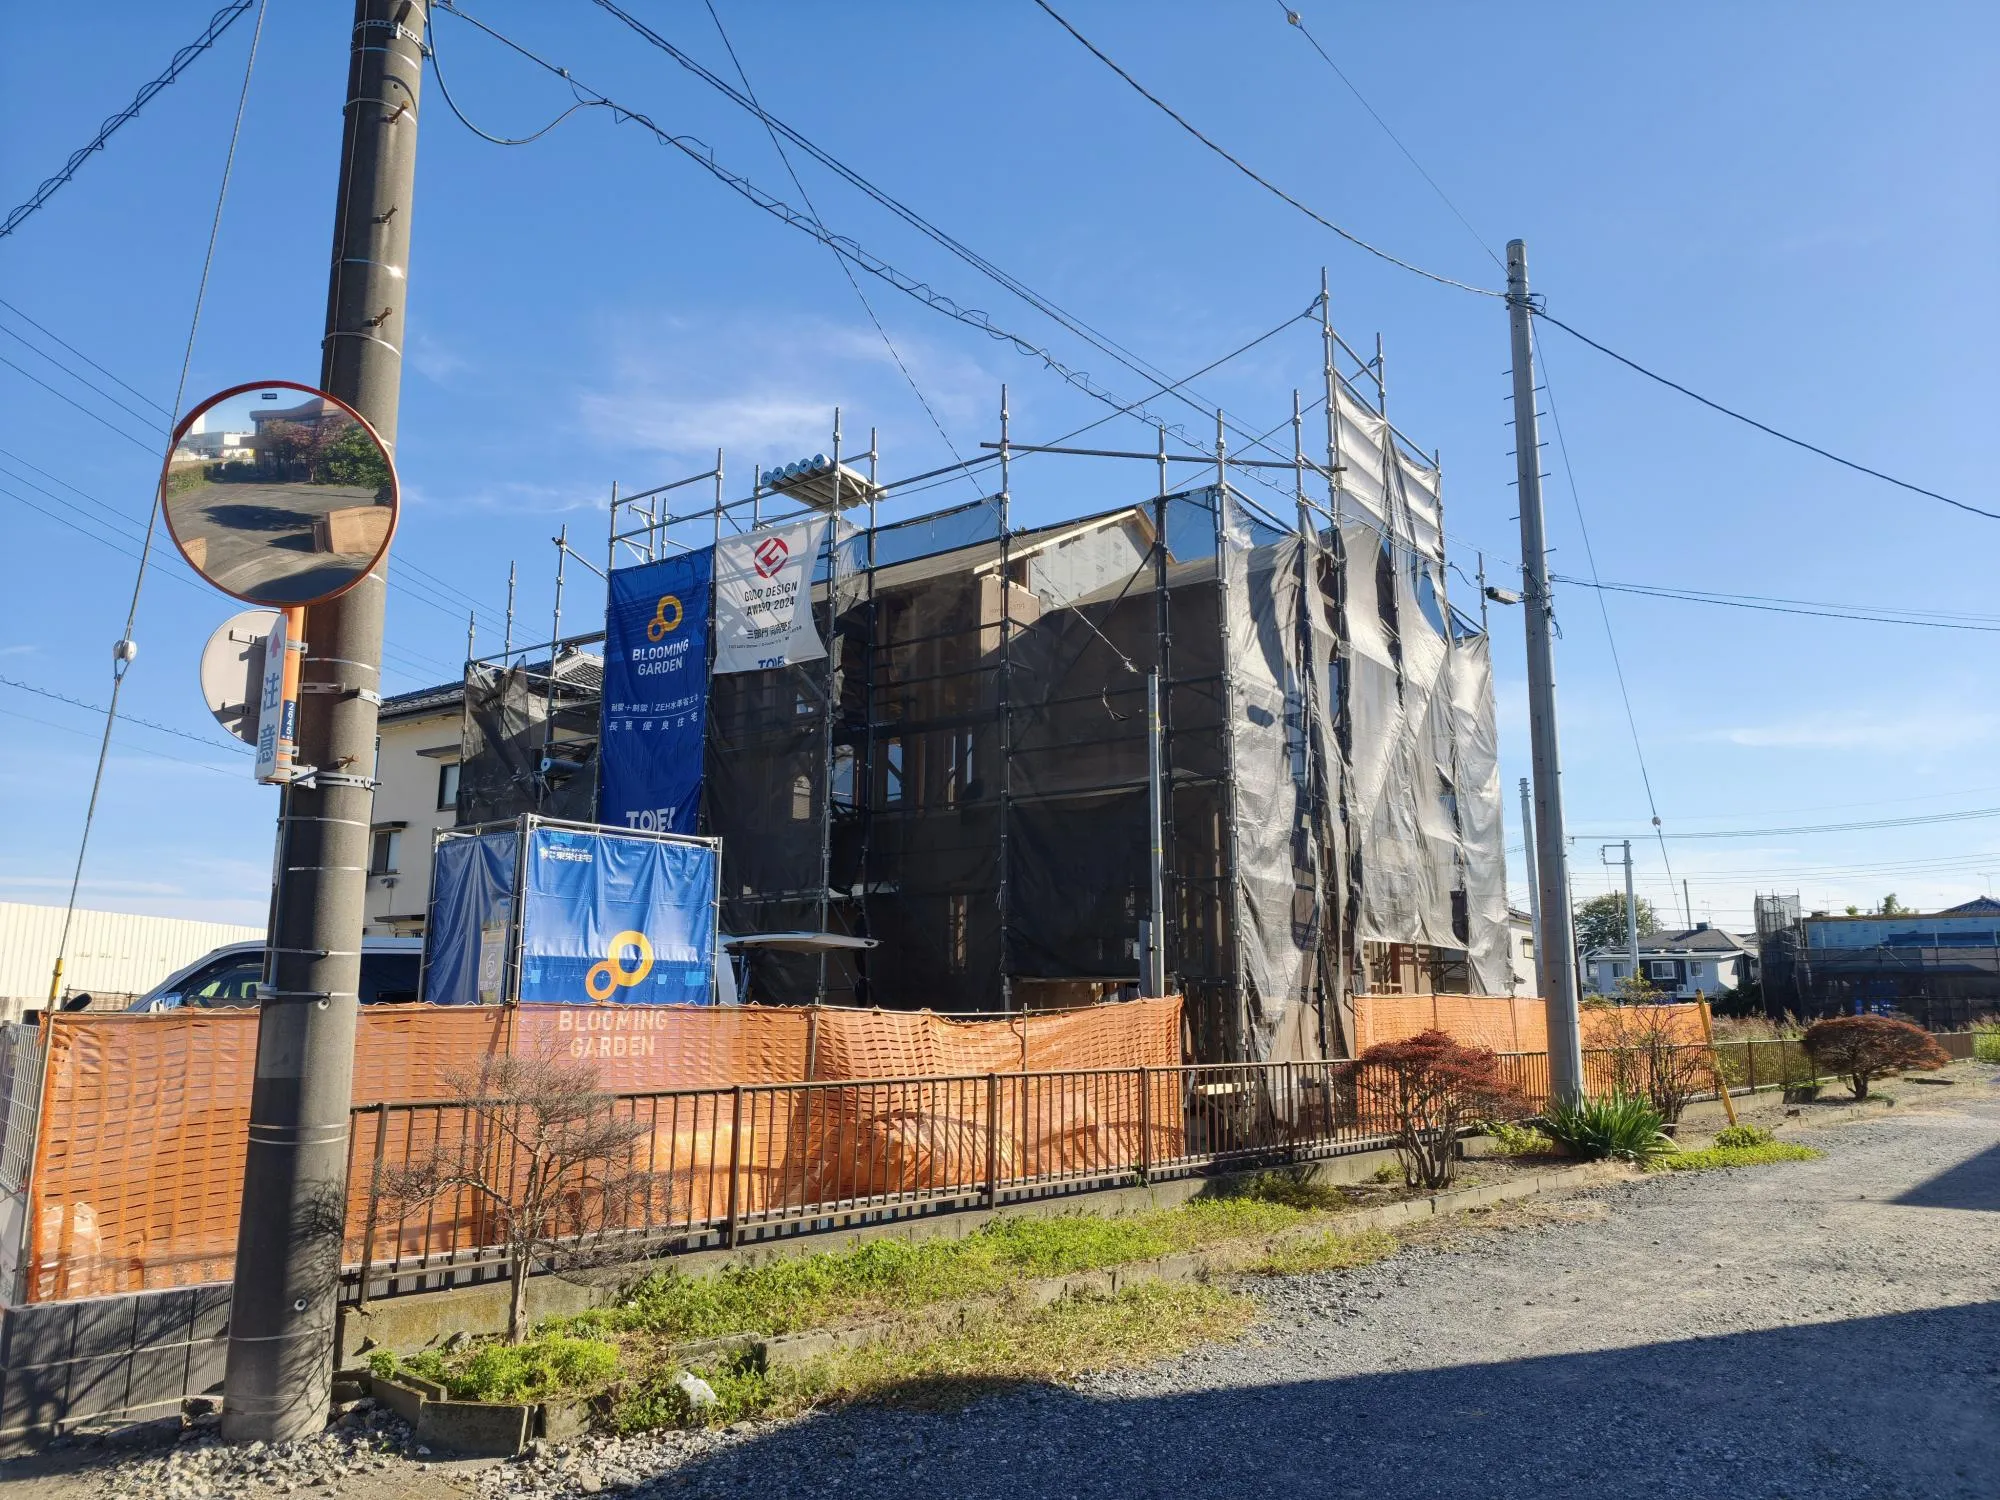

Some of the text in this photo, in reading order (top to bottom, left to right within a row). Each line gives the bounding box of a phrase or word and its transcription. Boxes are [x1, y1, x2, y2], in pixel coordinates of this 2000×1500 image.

[744, 581, 798, 601] GOOD DESIGN
[747, 596, 795, 616] AWARD 2024
[632, 639, 689, 661] BLOOMING
[638, 656, 683, 676] GARDEN
[258, 672, 280, 765] 注意
[286, 702, 295, 735] 2645
[559, 1009, 668, 1032] BLOOMING
[570, 1035, 655, 1058] GARDEN
